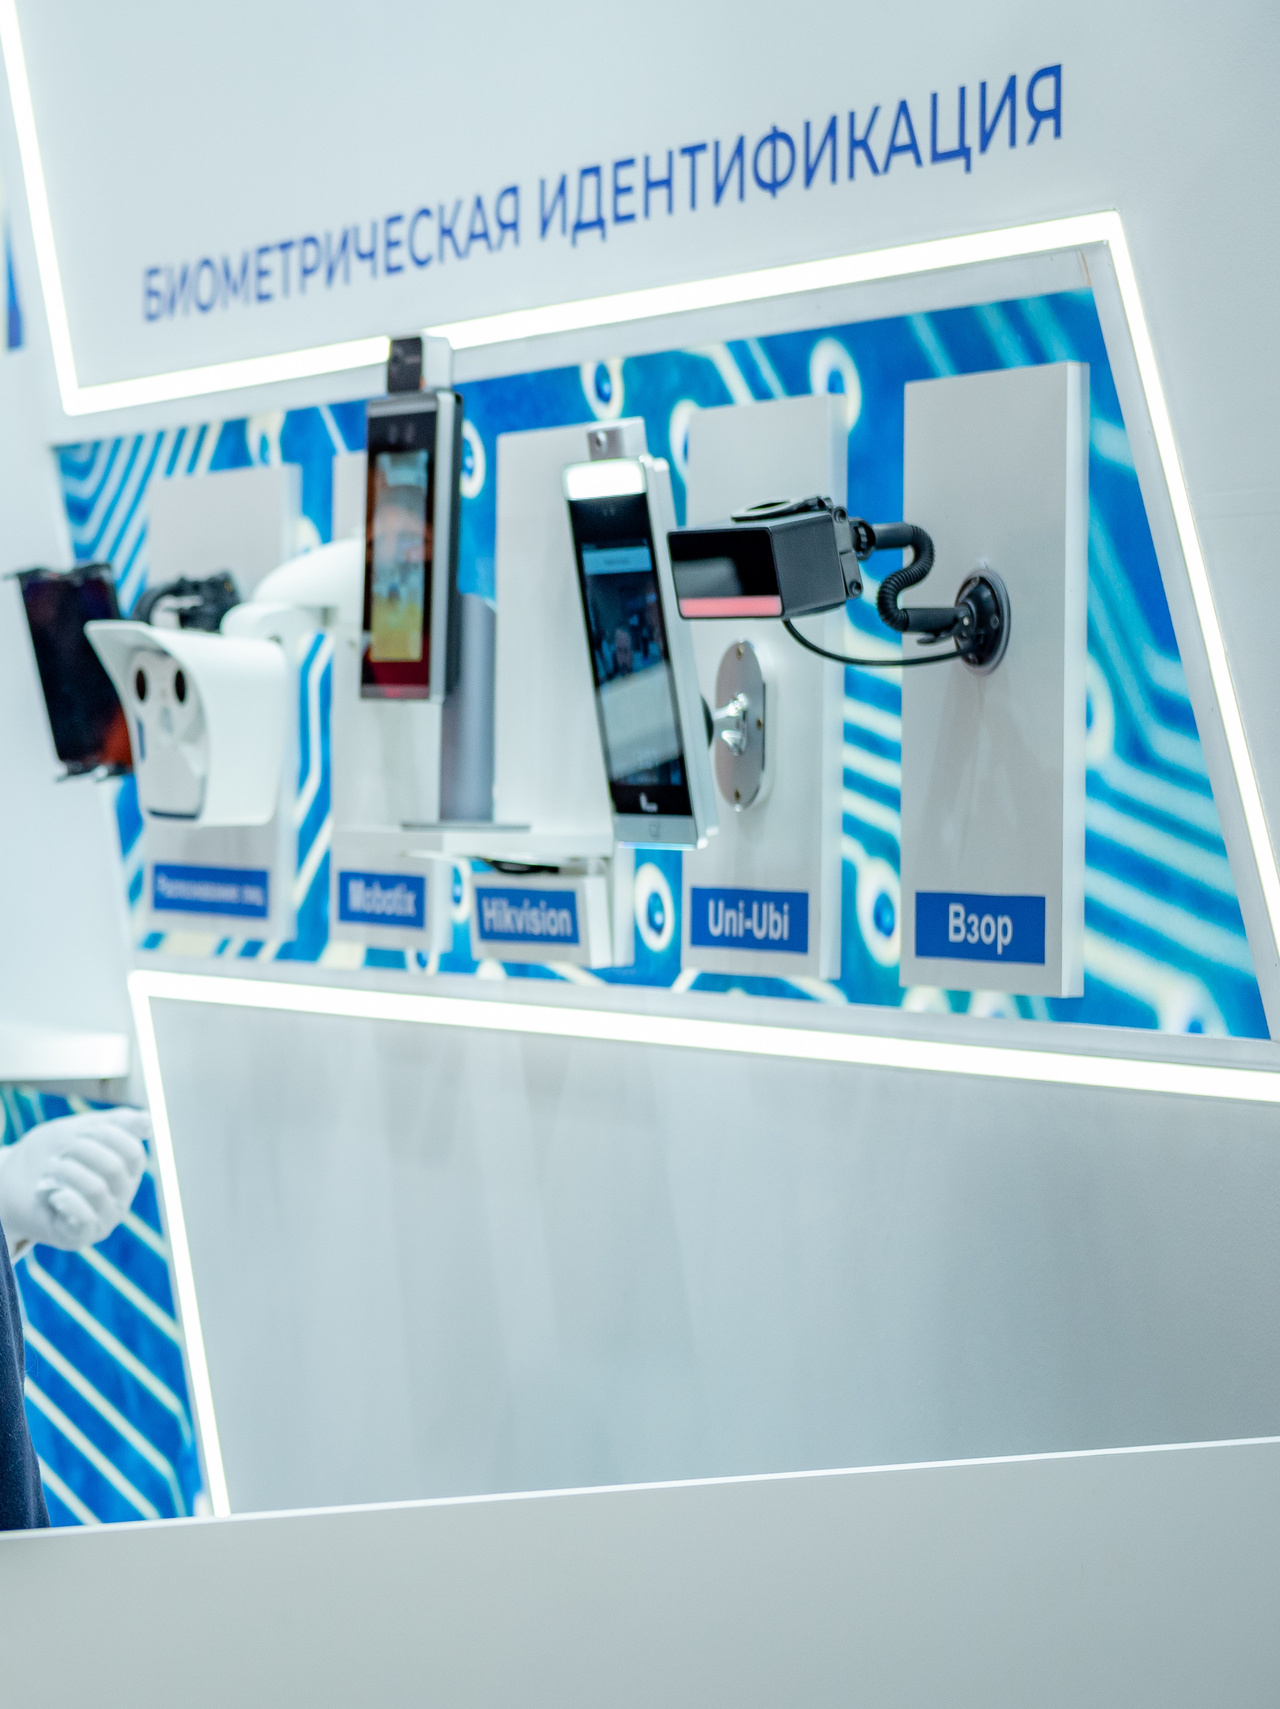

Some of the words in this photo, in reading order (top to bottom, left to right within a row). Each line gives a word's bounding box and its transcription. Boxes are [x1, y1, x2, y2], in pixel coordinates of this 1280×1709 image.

[144, 185, 521, 322] БИОМЕТРИЧЕСКАЯ
[538, 64, 1063, 246] ИДЕНТИФИКАЦИЯ
[482, 896, 573, 937] Hikvision
[708, 899, 790, 941] Uni-Ubi
[948, 902, 1014, 955] Взор
